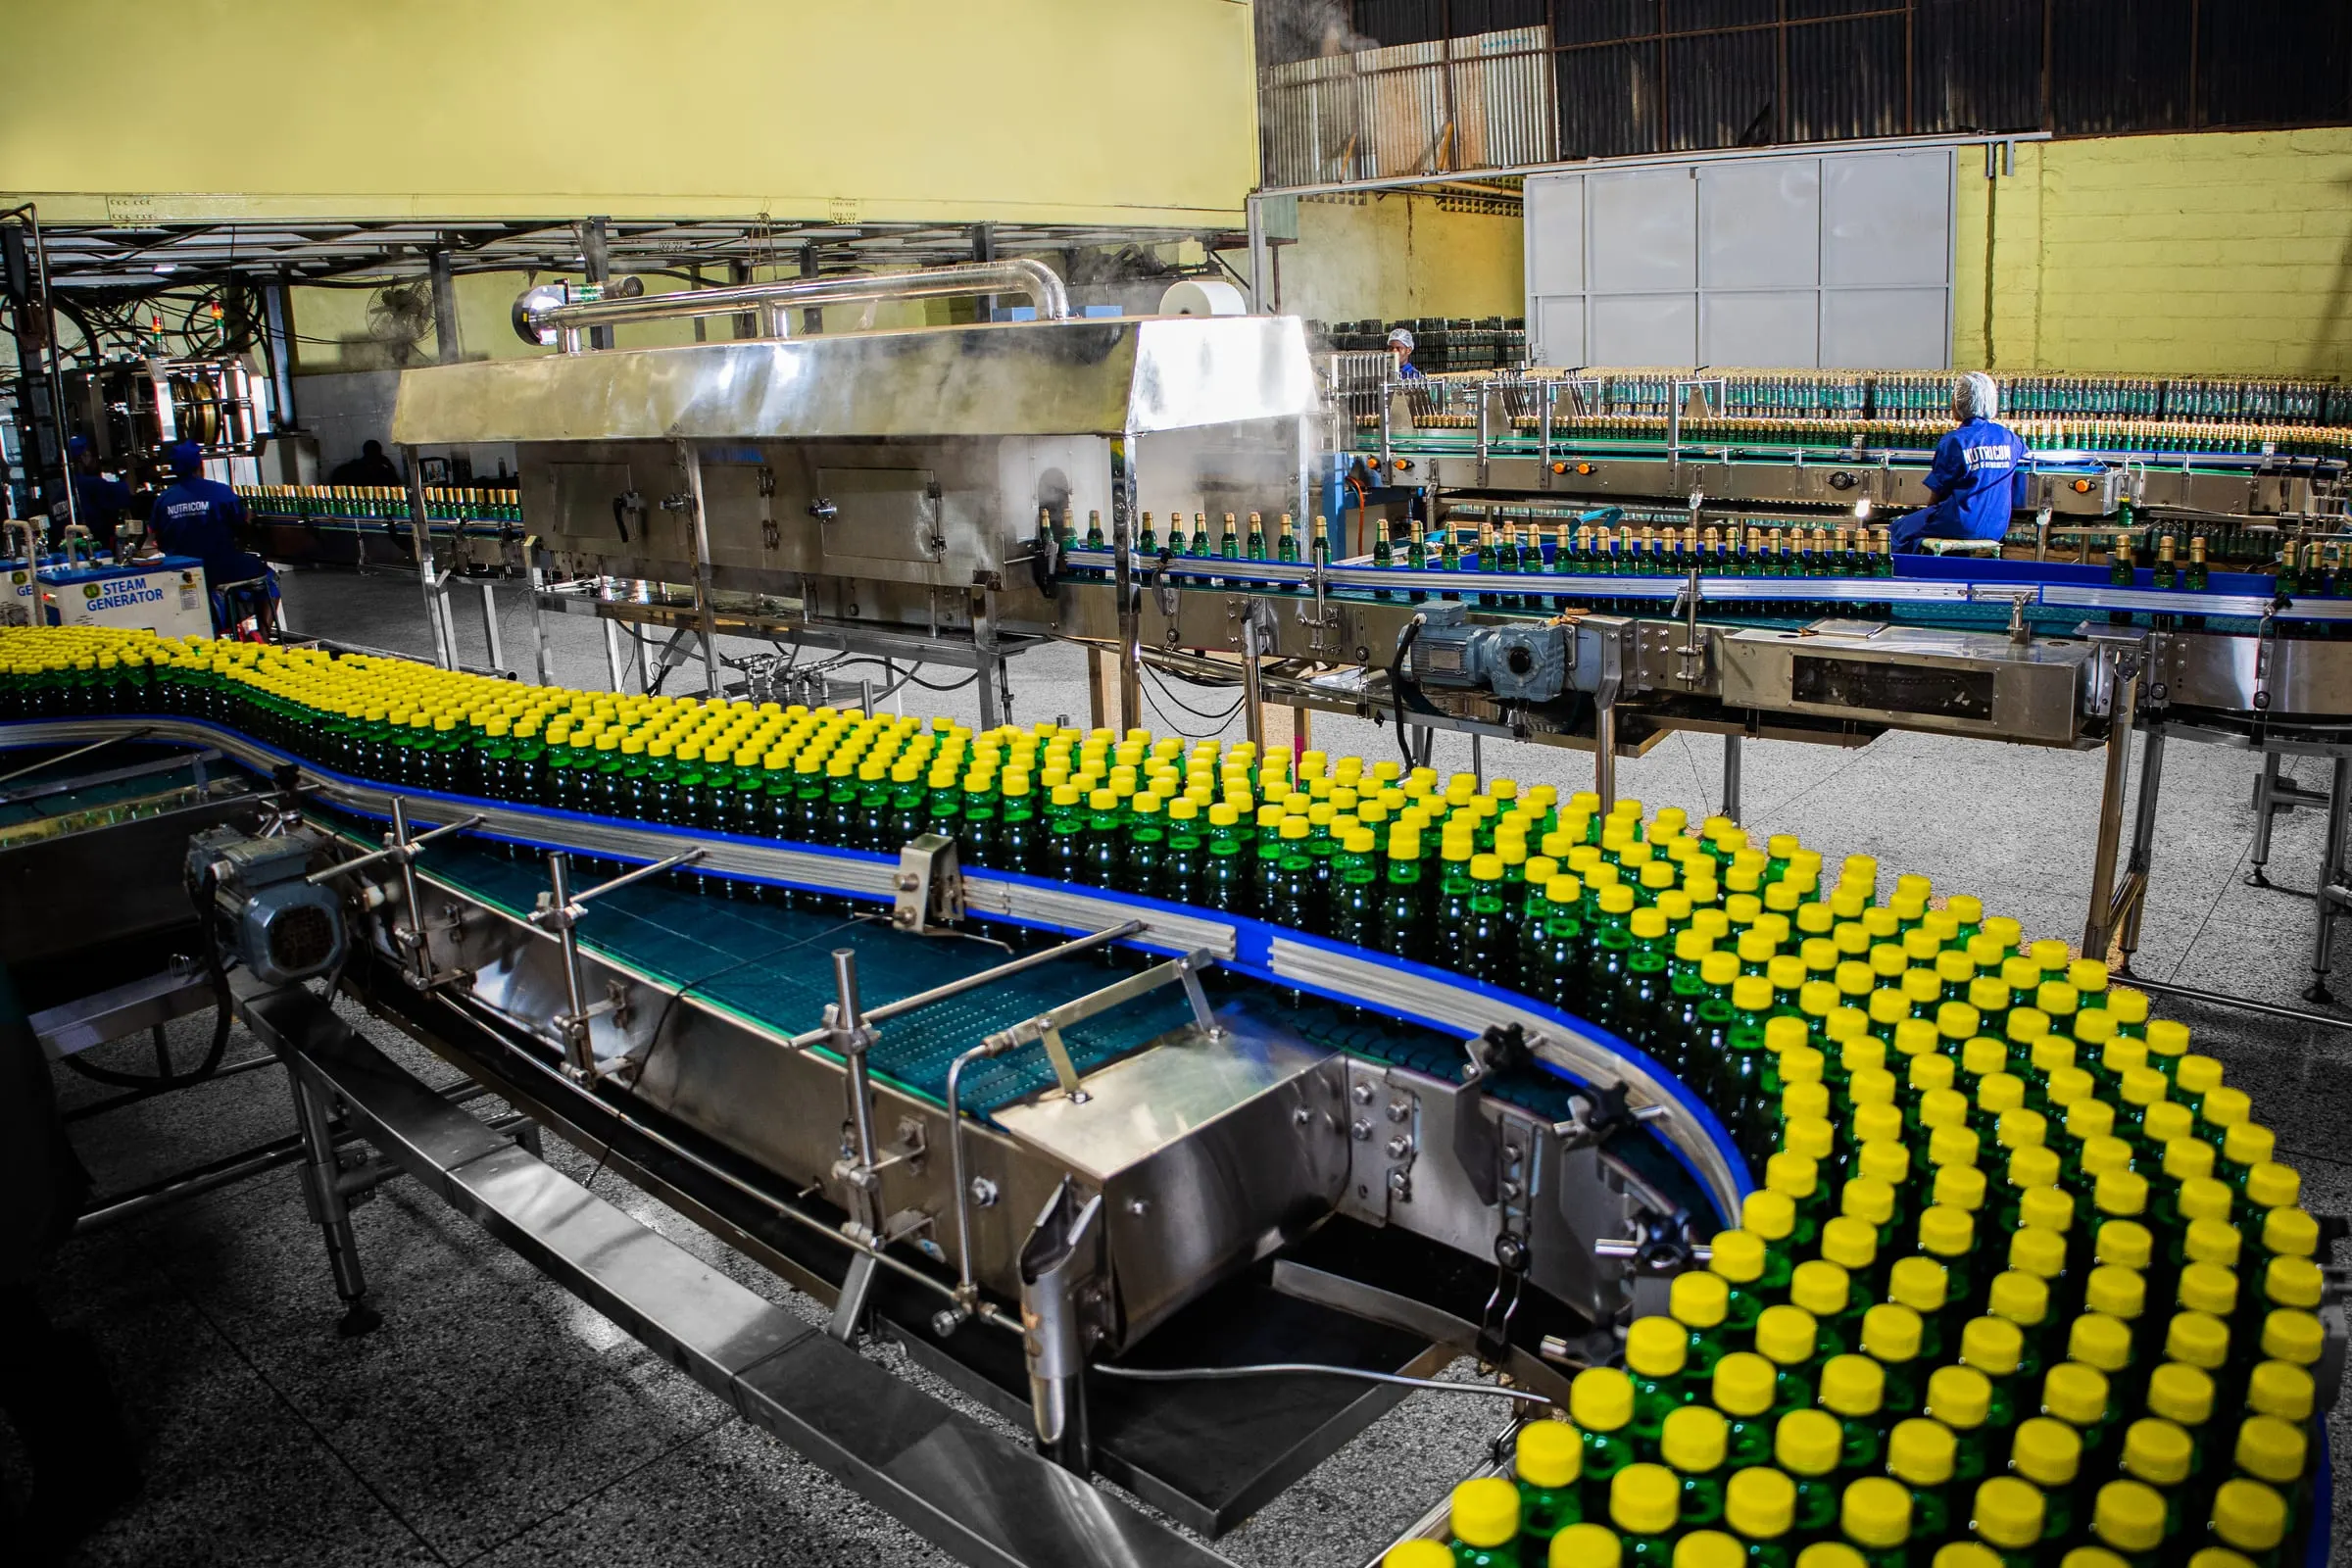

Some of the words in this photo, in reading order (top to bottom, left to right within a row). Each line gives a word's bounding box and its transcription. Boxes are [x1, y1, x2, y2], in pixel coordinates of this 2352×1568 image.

[1963, 445, 2011, 465] NUTRICOM
[167, 501, 210, 515] NUTRICOM
[103, 578, 147, 596] STEAM
[85, 588, 164, 612] GENERATOR
